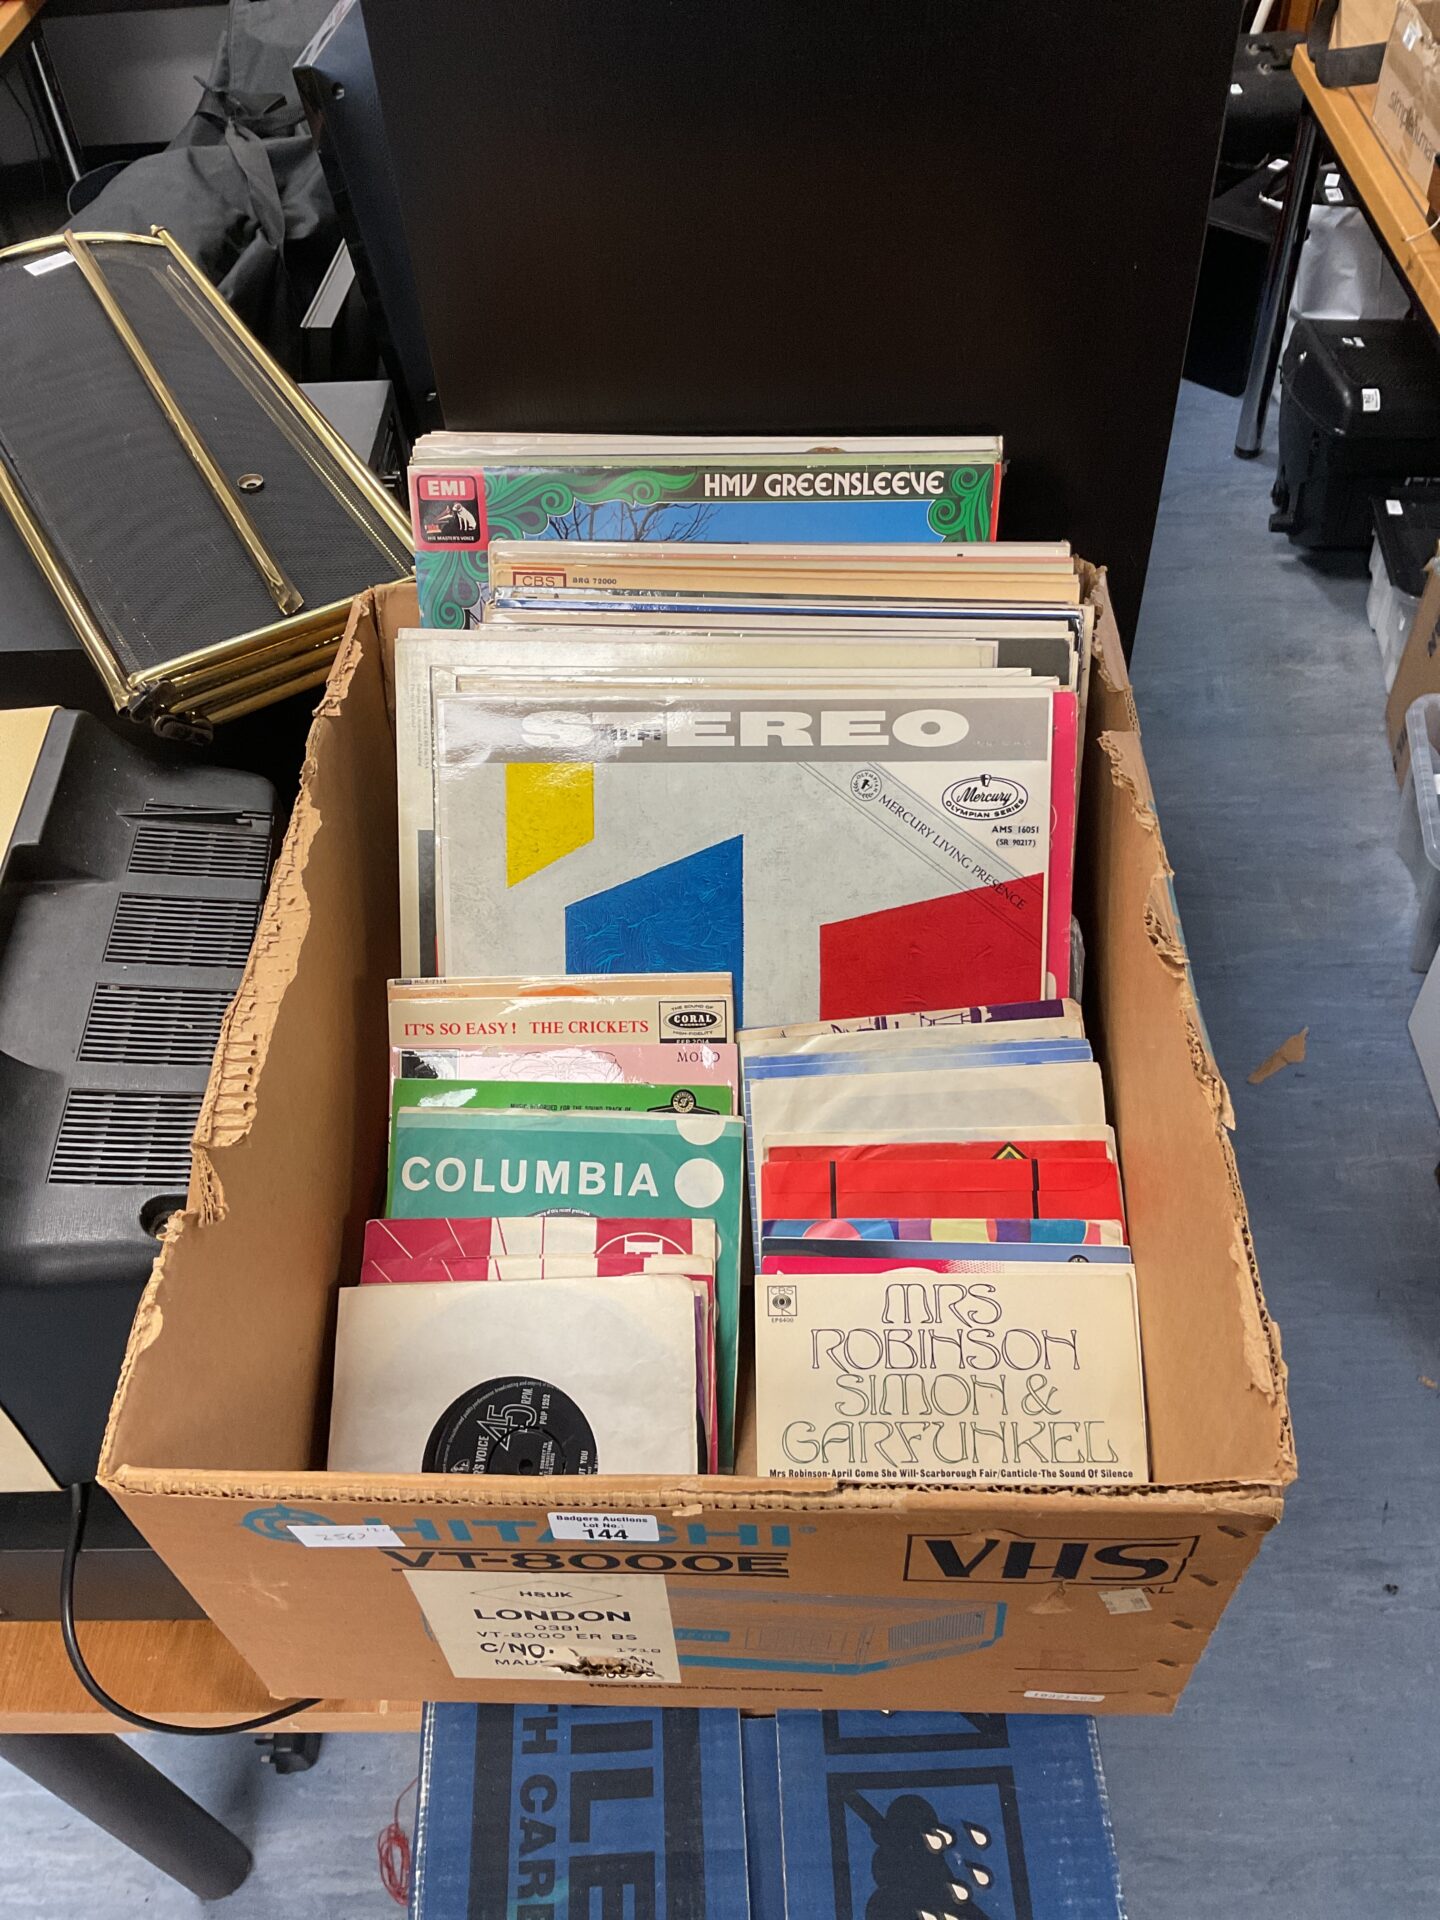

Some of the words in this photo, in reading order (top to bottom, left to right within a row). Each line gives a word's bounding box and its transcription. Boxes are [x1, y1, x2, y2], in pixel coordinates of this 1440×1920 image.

[427, 480, 466, 496] EMI
[704, 473, 758, 497] HMV
[764, 471, 944, 496] GREENSLEEVE
[522, 575, 555, 588] CBS
[520, 709, 970, 748] STEREO
[957, 786, 1012, 806] Mercury
[945, 800, 990, 818] OLYMPIAN
[993, 798, 1024, 817] SERIES
[992, 825, 1013, 833] AMS
[1018, 825, 1039, 833] 16051
[878, 794, 935, 839] MERCURY
[932, 835, 971, 870] LIVING
[970, 864, 1027, 911] PRESENCE
[404, 1021, 435, 1036] IT'S
[439, 1021, 461, 1036] SO
[529, 1020, 564, 1034] THE
[567, 1020, 649, 1034] CRICKETS
[673, 1014, 713, 1023] CORAL
[401, 1155, 660, 1198] COLUMBIA
[881, 1283, 1002, 1328] MRS
[810, 1328, 1081, 1374] ROBINSON
[835, 1373, 1009, 1416] SIMON
[1021, 1374, 1062, 1416] &
[477, 1403, 537, 1451] 45
[539, 1411, 548, 1425] POP
[474, 1435, 489, 1462] VOICE
[781, 1420, 1120, 1468] GARFUNKEL
[580, 1450, 588, 1464] YOU
[769, 1469, 786, 1478] Mrs
[855, 1469, 879, 1478] Come
[881, 1469, 897, 1478] She
[1059, 1469, 1086, 1478] Sound
[1087, 1469, 1098, 1478] Of
[1100, 1469, 1134, 1478] Silence
[582, 1528, 629, 1539] 144
[378, 1550, 789, 1575] VT-8000E
[925, 1538, 1181, 1581] VHS
[473, 1608, 632, 1622] LONDON
[476, 1631, 566, 1640] VT-8000
